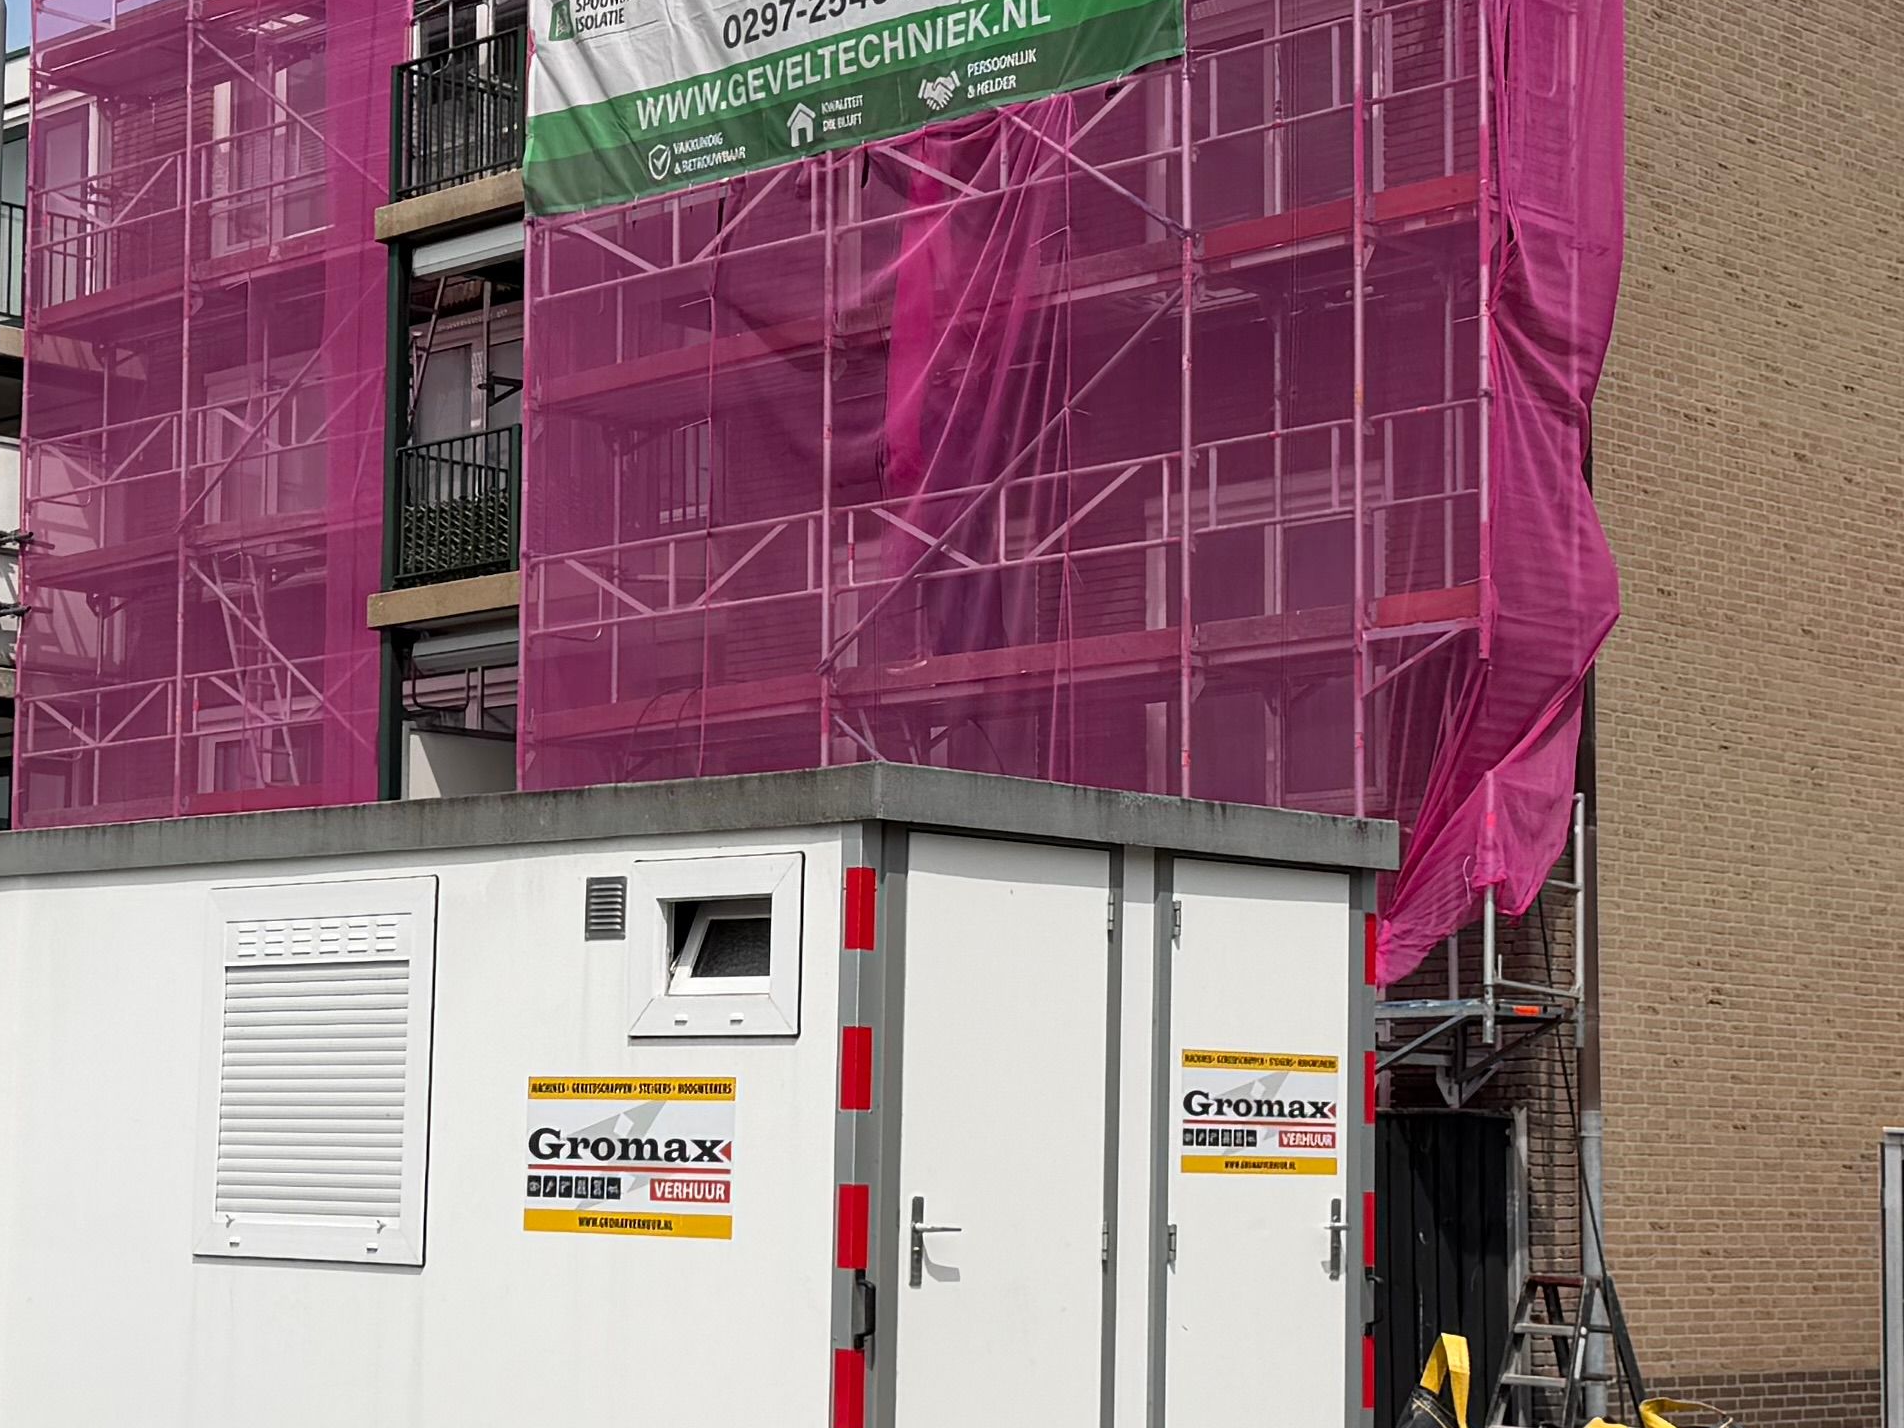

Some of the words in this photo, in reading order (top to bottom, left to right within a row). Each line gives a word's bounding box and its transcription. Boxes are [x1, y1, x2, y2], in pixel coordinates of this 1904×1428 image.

[575, 8, 625, 33] ISOLATIE
[1183, 1090, 1331, 1119] Gromax
[528, 1127, 725, 1163] Gromax
[1282, 1133, 1333, 1147] VERHUUR
[654, 1181, 726, 1201] VERHUUR
